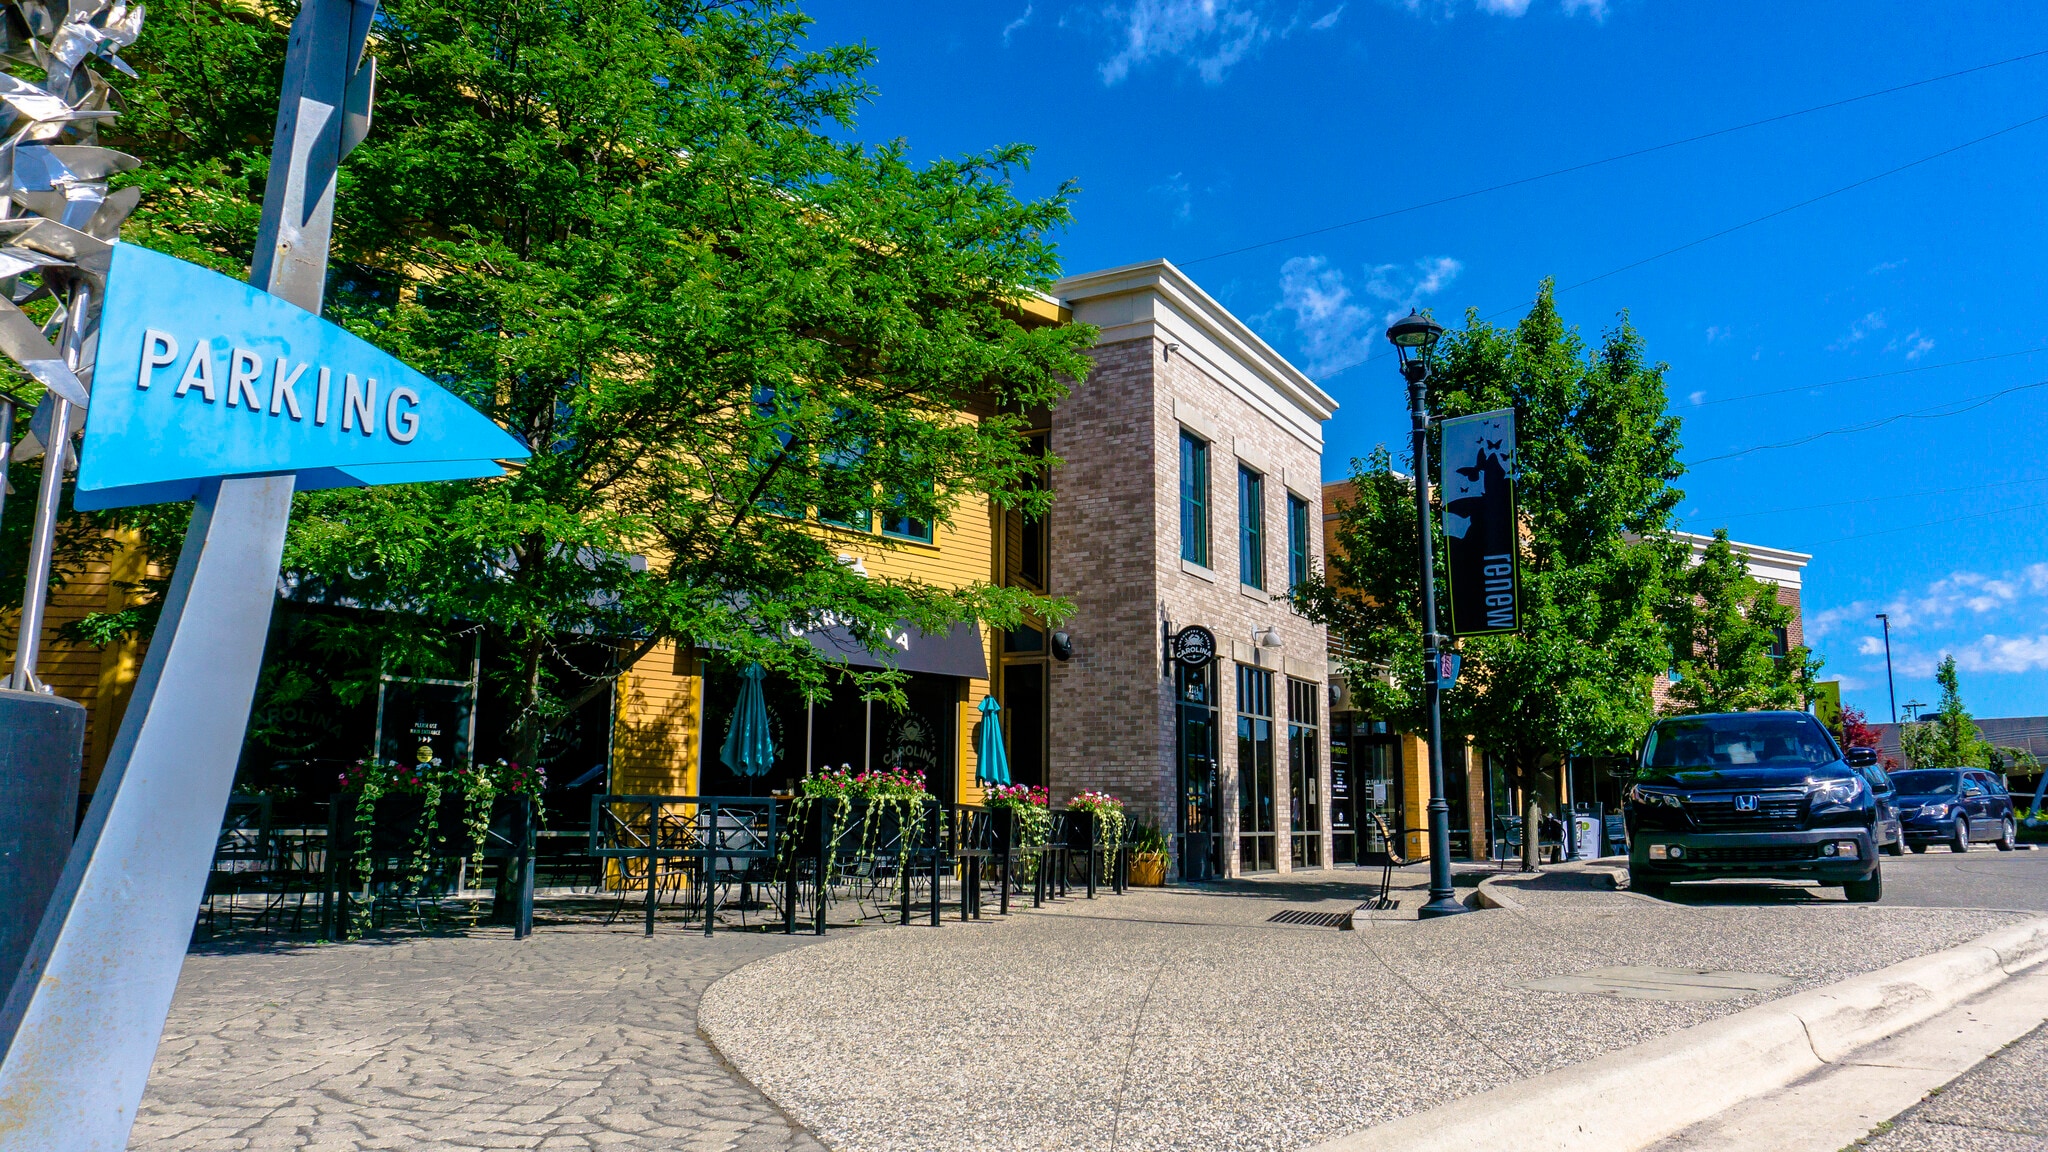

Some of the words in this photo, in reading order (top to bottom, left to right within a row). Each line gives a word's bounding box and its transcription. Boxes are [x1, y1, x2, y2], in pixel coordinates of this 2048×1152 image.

[138, 328, 420, 443] PARKING
[1483, 553, 1515, 628] renew
[1176, 646, 1212, 659] CAROLINA
[253, 706, 344, 740] AROLINA
[883, 744, 938, 768] CAROLINA
